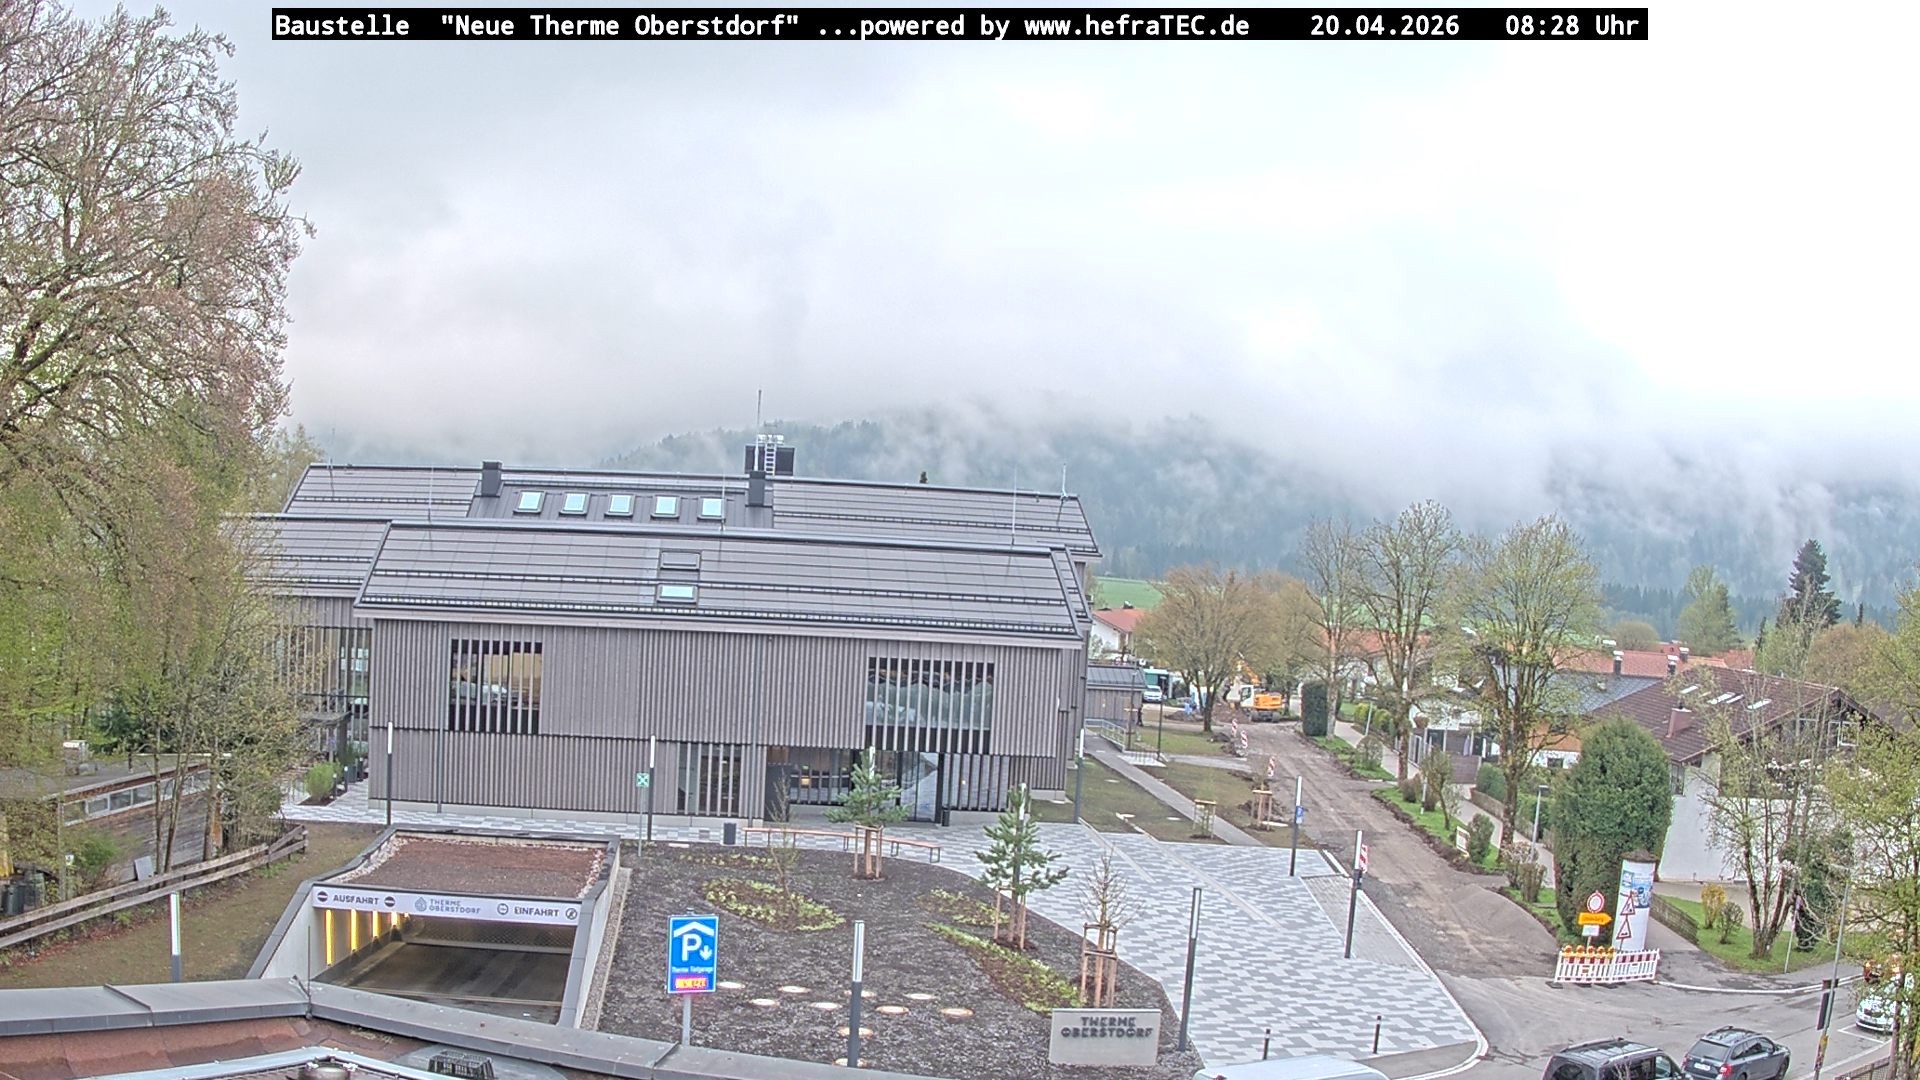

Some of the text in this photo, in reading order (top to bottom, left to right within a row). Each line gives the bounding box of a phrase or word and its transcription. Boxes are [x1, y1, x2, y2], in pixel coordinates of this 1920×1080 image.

[333, 894, 379, 905] AUSFAHRT
[430, 898, 461, 907] THERME
[430, 905, 481, 914] OBERSTDORF
[514, 906, 560, 917] EINFAHRT
[682, 933, 702, 962] P
[1081, 1016, 1136, 1027] THERME
[1061, 1027, 1153, 1038] OBERSTDORF
